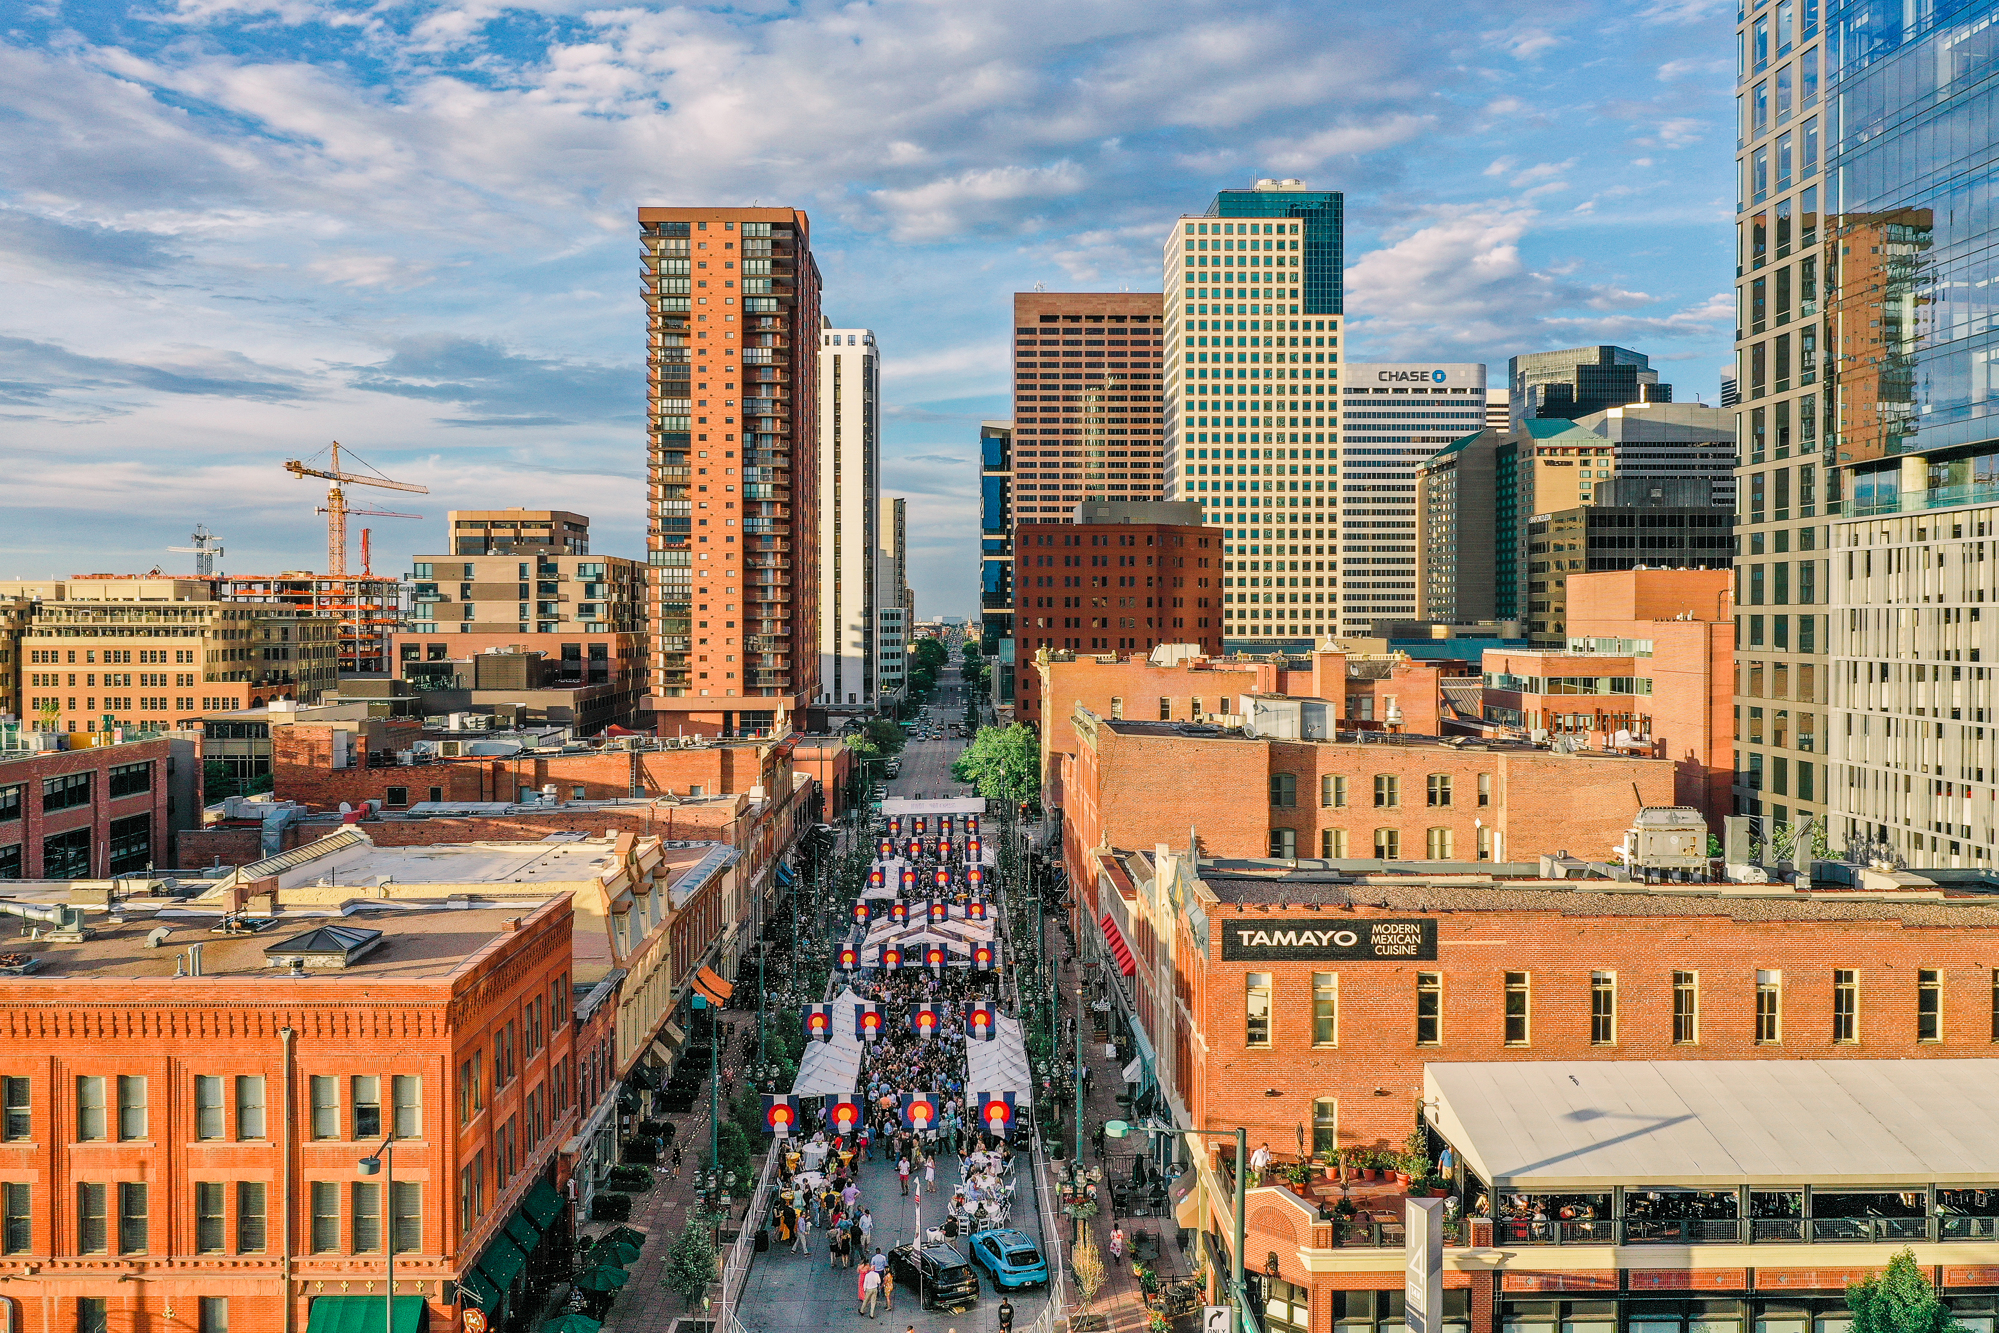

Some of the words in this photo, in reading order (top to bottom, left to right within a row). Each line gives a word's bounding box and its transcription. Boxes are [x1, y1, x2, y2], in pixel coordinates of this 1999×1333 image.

[1378, 371, 1430, 382] CHASE
[1372, 923, 1420, 934] MODERN
[1237, 930, 1358, 946] TAMAYO
[1371, 934, 1421, 945] MEXICAN
[1375, 945, 1417, 955] CUISINE
